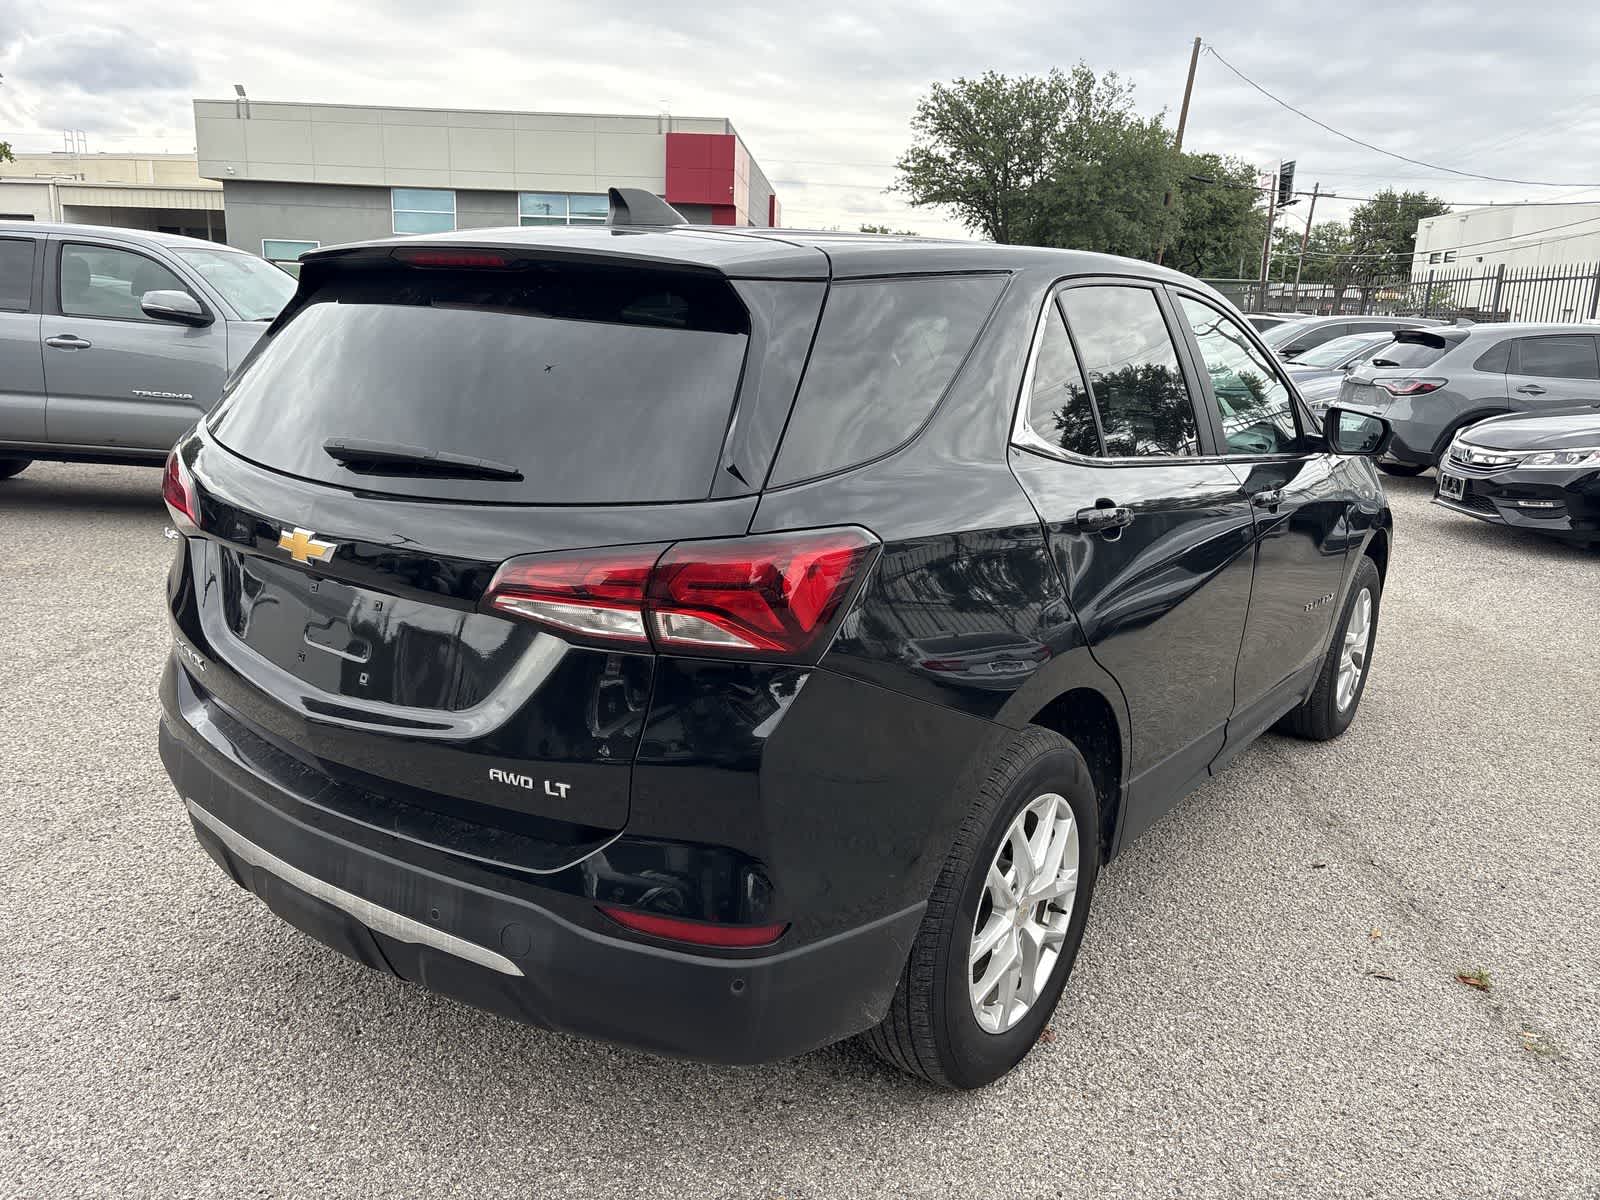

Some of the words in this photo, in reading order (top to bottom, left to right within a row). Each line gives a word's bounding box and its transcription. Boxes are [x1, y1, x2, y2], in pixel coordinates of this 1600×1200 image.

[132, 389, 193, 400] TACOMA
[489, 768, 534, 790] AWD
[544, 780, 571, 799] LT
